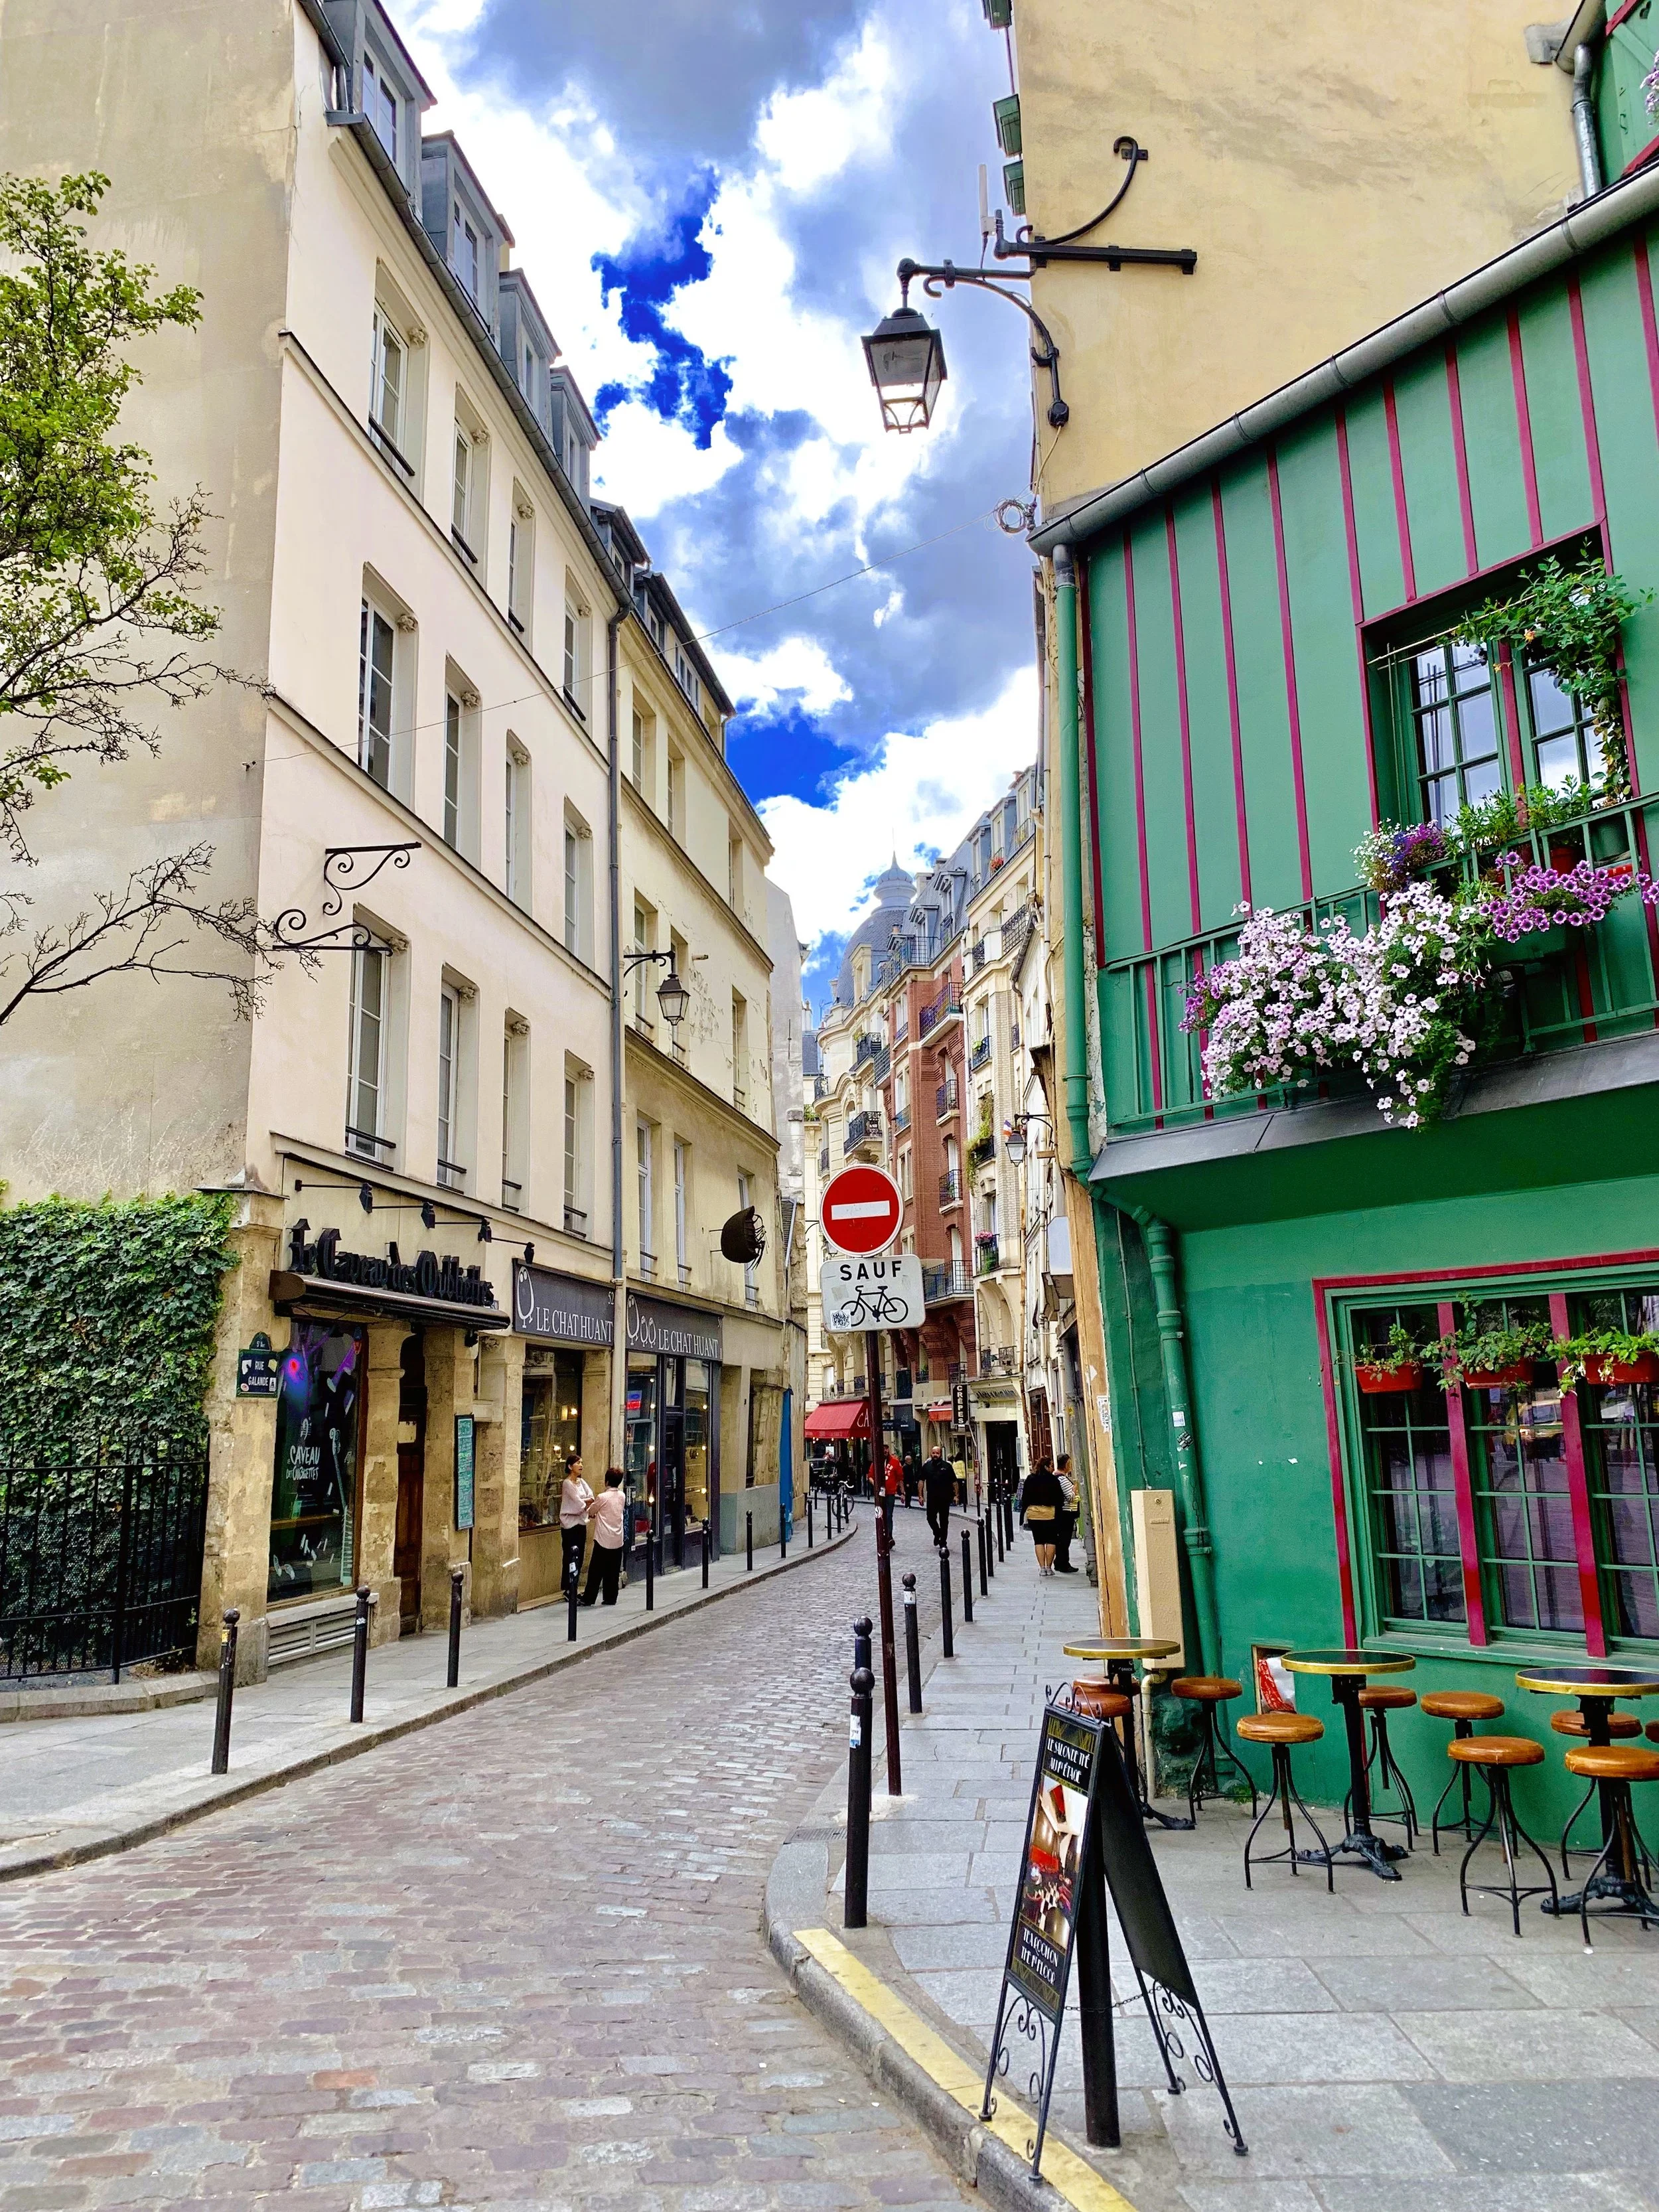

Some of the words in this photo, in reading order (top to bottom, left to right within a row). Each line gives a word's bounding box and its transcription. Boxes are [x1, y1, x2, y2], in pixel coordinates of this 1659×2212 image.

[317, 1228, 388, 1288] Caveau
[388, 1241, 417, 1293] des
[415, 1250, 494, 1306] Oubliettes
[840, 1260, 902, 1282] SAUF
[608, 1291, 614, 1305] 52
[536, 1307, 551, 1333] LE
[552, 1309, 579, 1337] CHAT
[581, 1315, 613, 1342] HUANT
[658, 1329, 670, 1351] LE
[670, 1331, 692, 1353] CHAT
[693, 1334, 719, 1359] HUANT
[254, 1361, 264, 1370] RUE
[248, 1376, 269, 1386] GALANDE
[290, 1445, 320, 1465] CAVEAU
[1047, 1737, 1054, 1752] LE
[1053, 1741, 1071, 1761] SALON
[1070, 1748, 1080, 1763] DE
[1050, 1757, 1058, 1771] AU
[1023, 1927, 1033, 1947] TEA
[1033, 1936, 1050, 1960] ROOM
[1049, 1949, 1059, 1967] ON
[1021, 1945, 1031, 1965] THE
[1036, 1959, 1056, 1986] FLOOR
